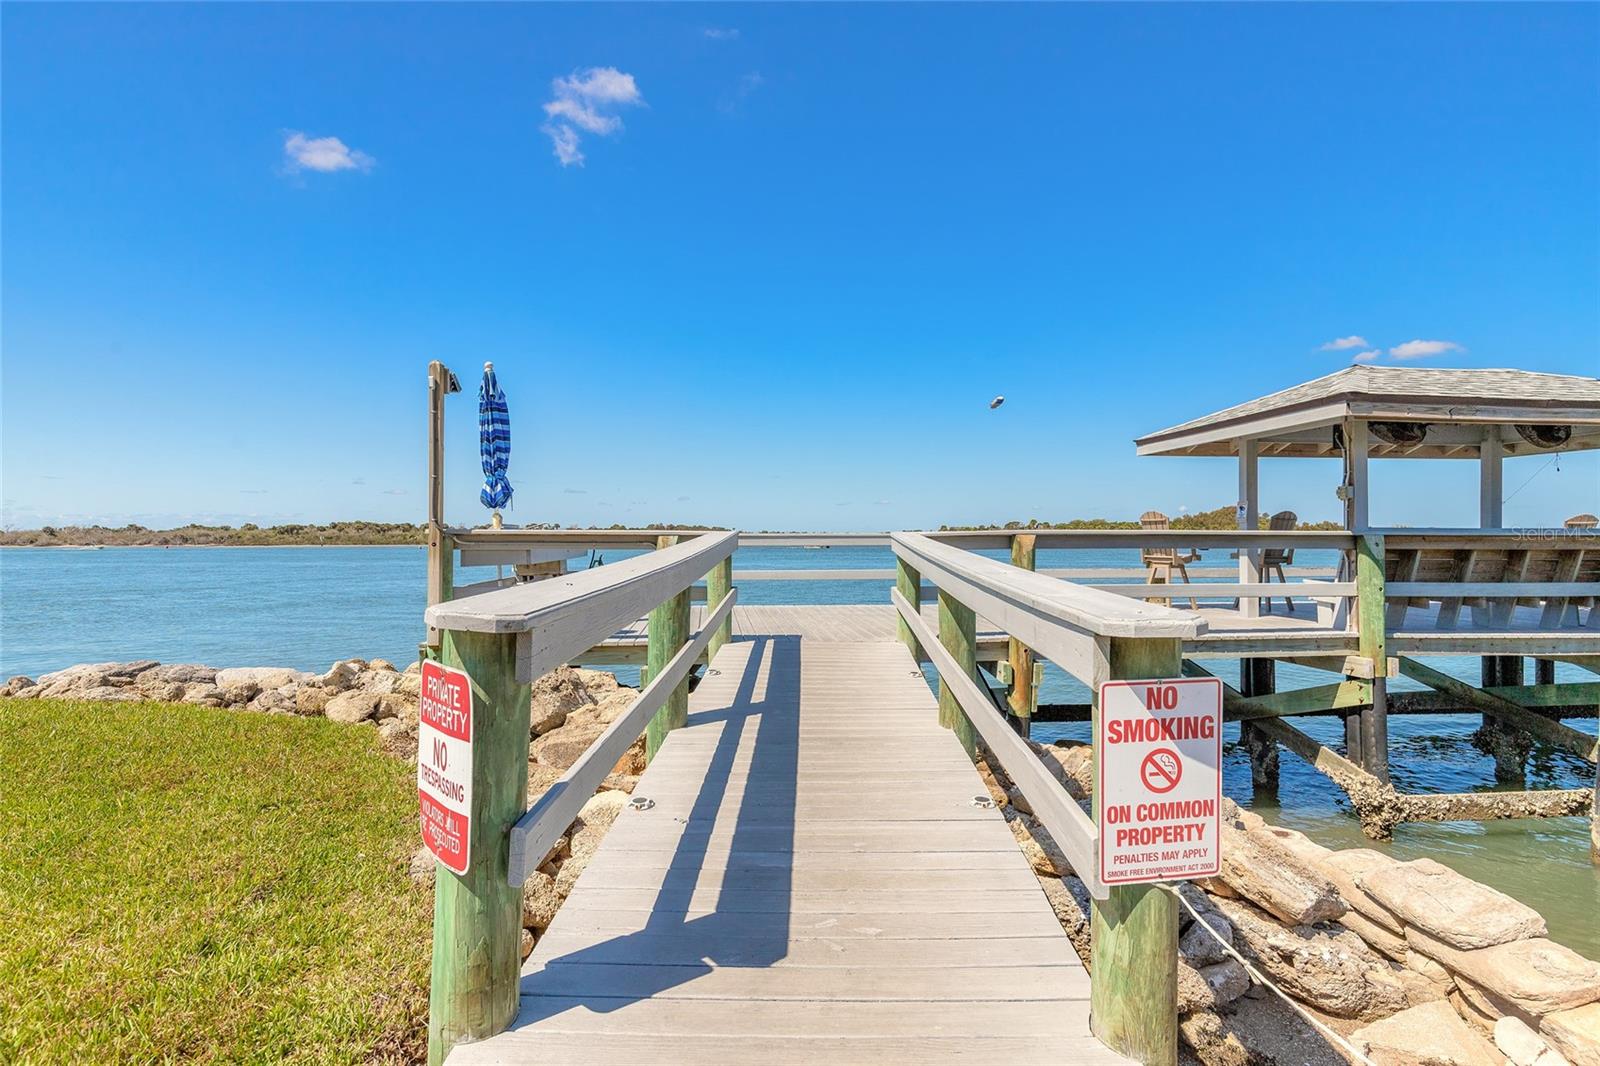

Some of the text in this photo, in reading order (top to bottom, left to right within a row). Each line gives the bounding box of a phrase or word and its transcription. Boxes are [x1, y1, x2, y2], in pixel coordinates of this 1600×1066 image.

[427, 676, 461, 708] PRIVATE
[1146, 686, 1178, 710] NO
[422, 697, 467, 734] PROPERTY
[1108, 715, 1214, 744] SMOKING
[433, 737, 447, 771] NO
[421, 763, 464, 803] TRESPASSING
[1107, 799, 1214, 824] ON COMMON
[429, 821, 460, 854] PROSECUTED
[1116, 823, 1206, 847] PROPERTY
[1113, 848, 1208, 865] PENALTIES MAY APPLY
[1108, 869, 1129, 878] SMOKE
[1130, 868, 1144, 876] FREE
[1146, 866, 1186, 875] ENVIRONMENT
